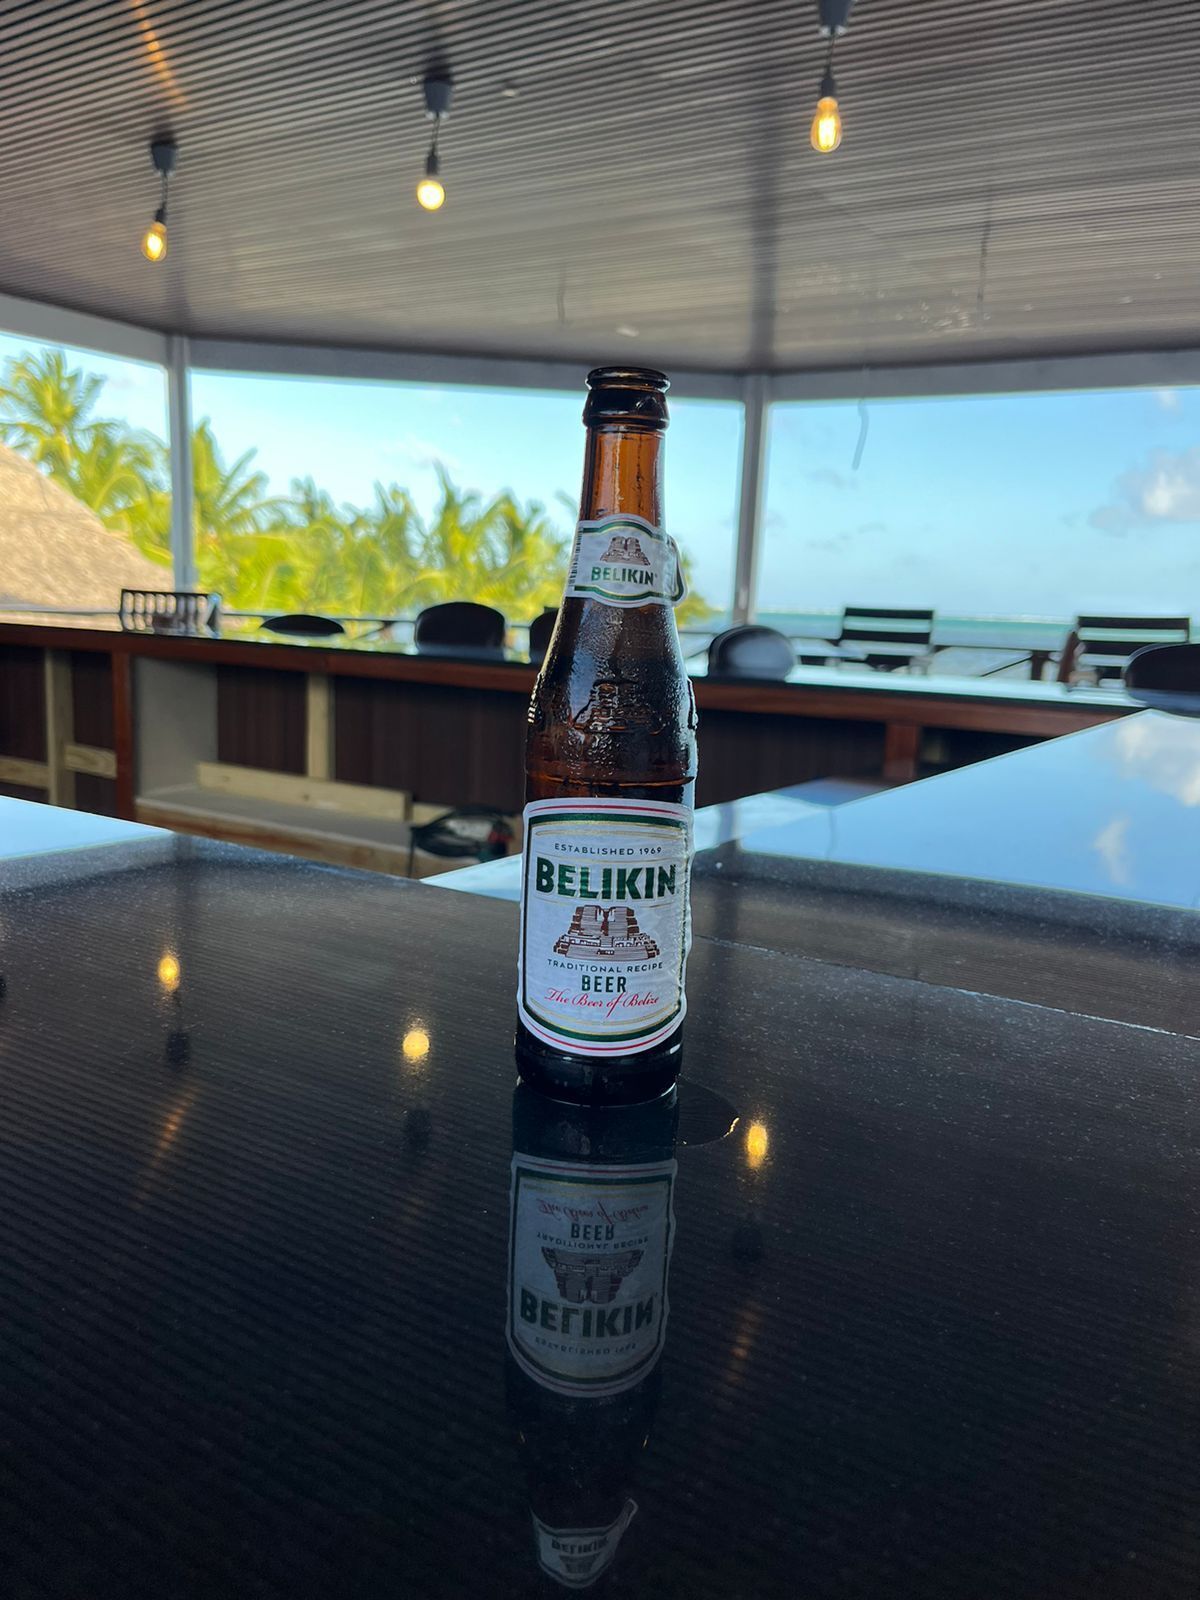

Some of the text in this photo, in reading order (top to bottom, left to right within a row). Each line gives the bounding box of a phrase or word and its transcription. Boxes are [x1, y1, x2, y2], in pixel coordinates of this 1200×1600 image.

[591, 566, 654, 586] BELIKIN
[554, 843, 662, 856] ESTABLISHED 1969
[536, 856, 676, 900] BELIKIN
[548, 959, 663, 973] TRADITIONAL RECIPE
[581, 975, 627, 993] BEER
[544, 987, 660, 1018] The Beer of Belize
